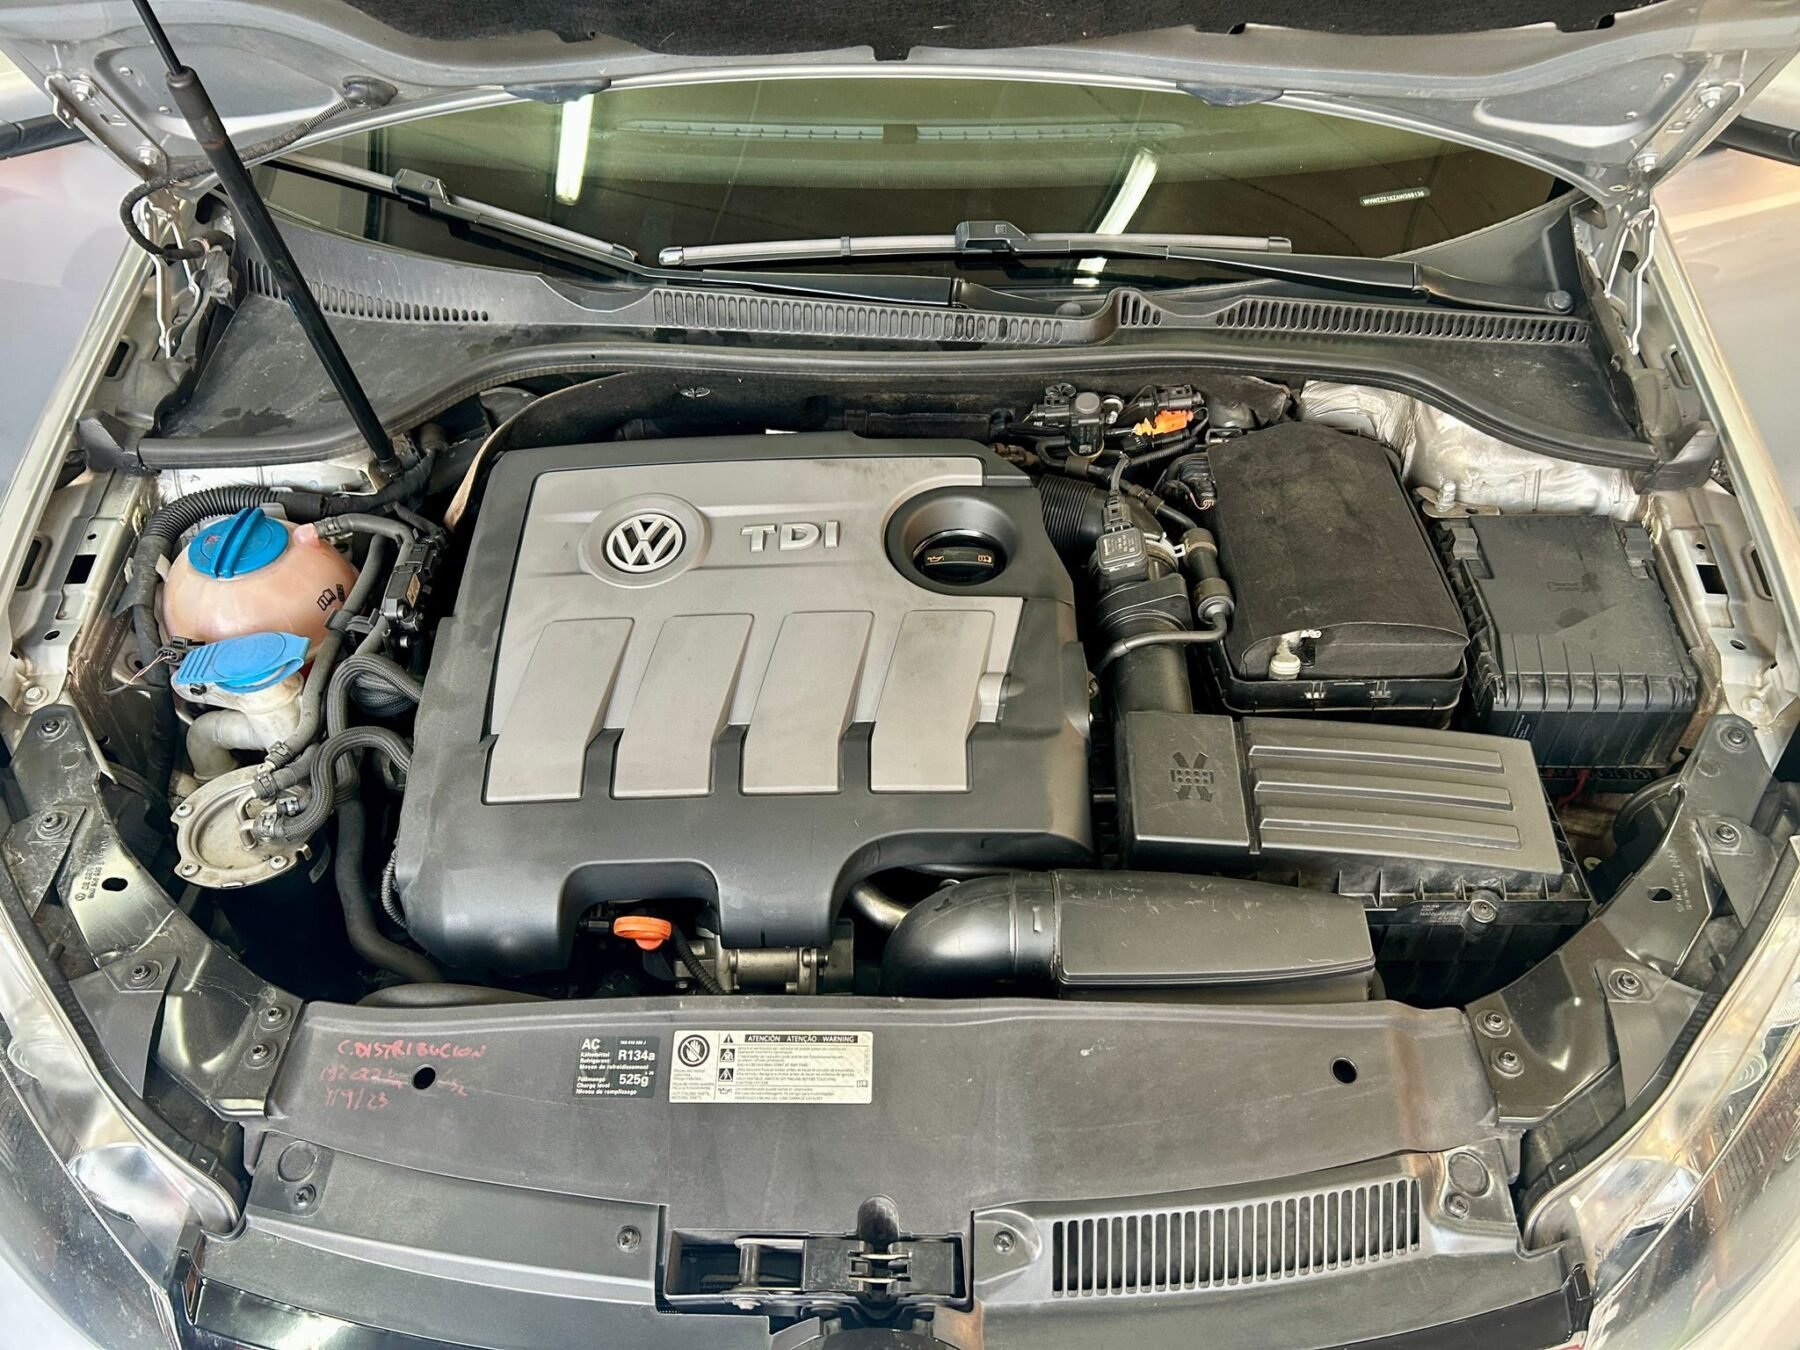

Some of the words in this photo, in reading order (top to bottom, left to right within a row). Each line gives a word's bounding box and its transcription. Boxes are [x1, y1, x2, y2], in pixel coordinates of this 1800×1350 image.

[741, 521, 840, 552] TDI
[581, 1038, 601, 1050] AC
[748, 1034, 780, 1042] ATENCIÓN
[786, 1034, 817, 1043] ATENÇÃO
[618, 1049, 656, 1061] R134a
[619, 1073, 649, 1088] 525g
